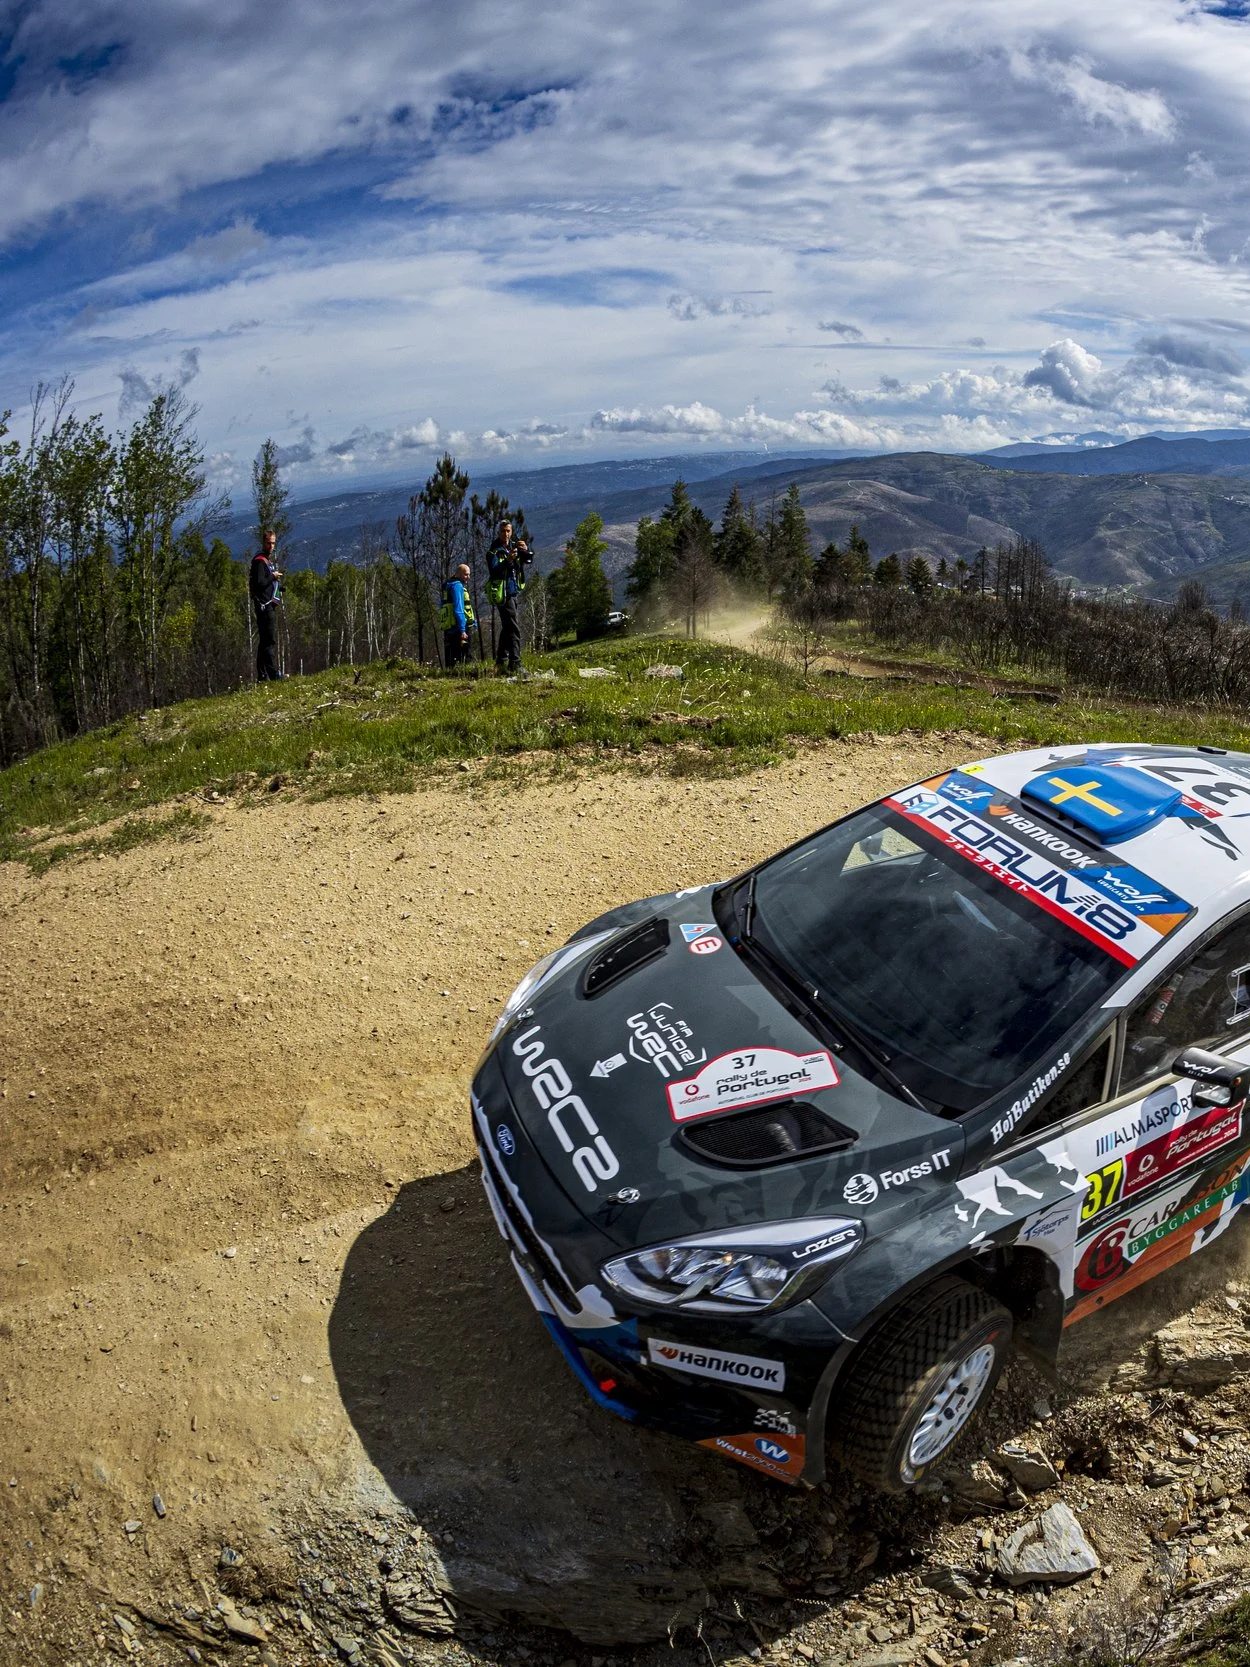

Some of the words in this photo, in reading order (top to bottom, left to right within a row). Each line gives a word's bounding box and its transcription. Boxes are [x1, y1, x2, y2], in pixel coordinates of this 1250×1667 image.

[927, 805, 1136, 940] FORUM8
[694, 939, 717, 952] E
[626, 1012, 683, 1078] WRC
[649, 1010, 695, 1063] JUNIOR
[675, 1020, 694, 1038] FIA
[716, 1072, 748, 1086] rally
[750, 1068, 768, 1078] de
[732, 1054, 757, 1070] 37
[679, 1093, 710, 1105] vodafone
[717, 1067, 811, 1096] Portugal
[512, 1025, 620, 1192] WRC2
[498, 1128, 513, 1151] Ford
[1165, 1111, 1238, 1160] Portugal
[880, 1160, 933, 1190] Forss
[932, 1149, 951, 1170] IT
[1127, 1166, 1159, 1187] vodafone
[1081, 1158, 1124, 1220] 37
[1131, 1199, 1211, 1254] BYGGARE
[1220, 1181, 1239, 1199] AB
